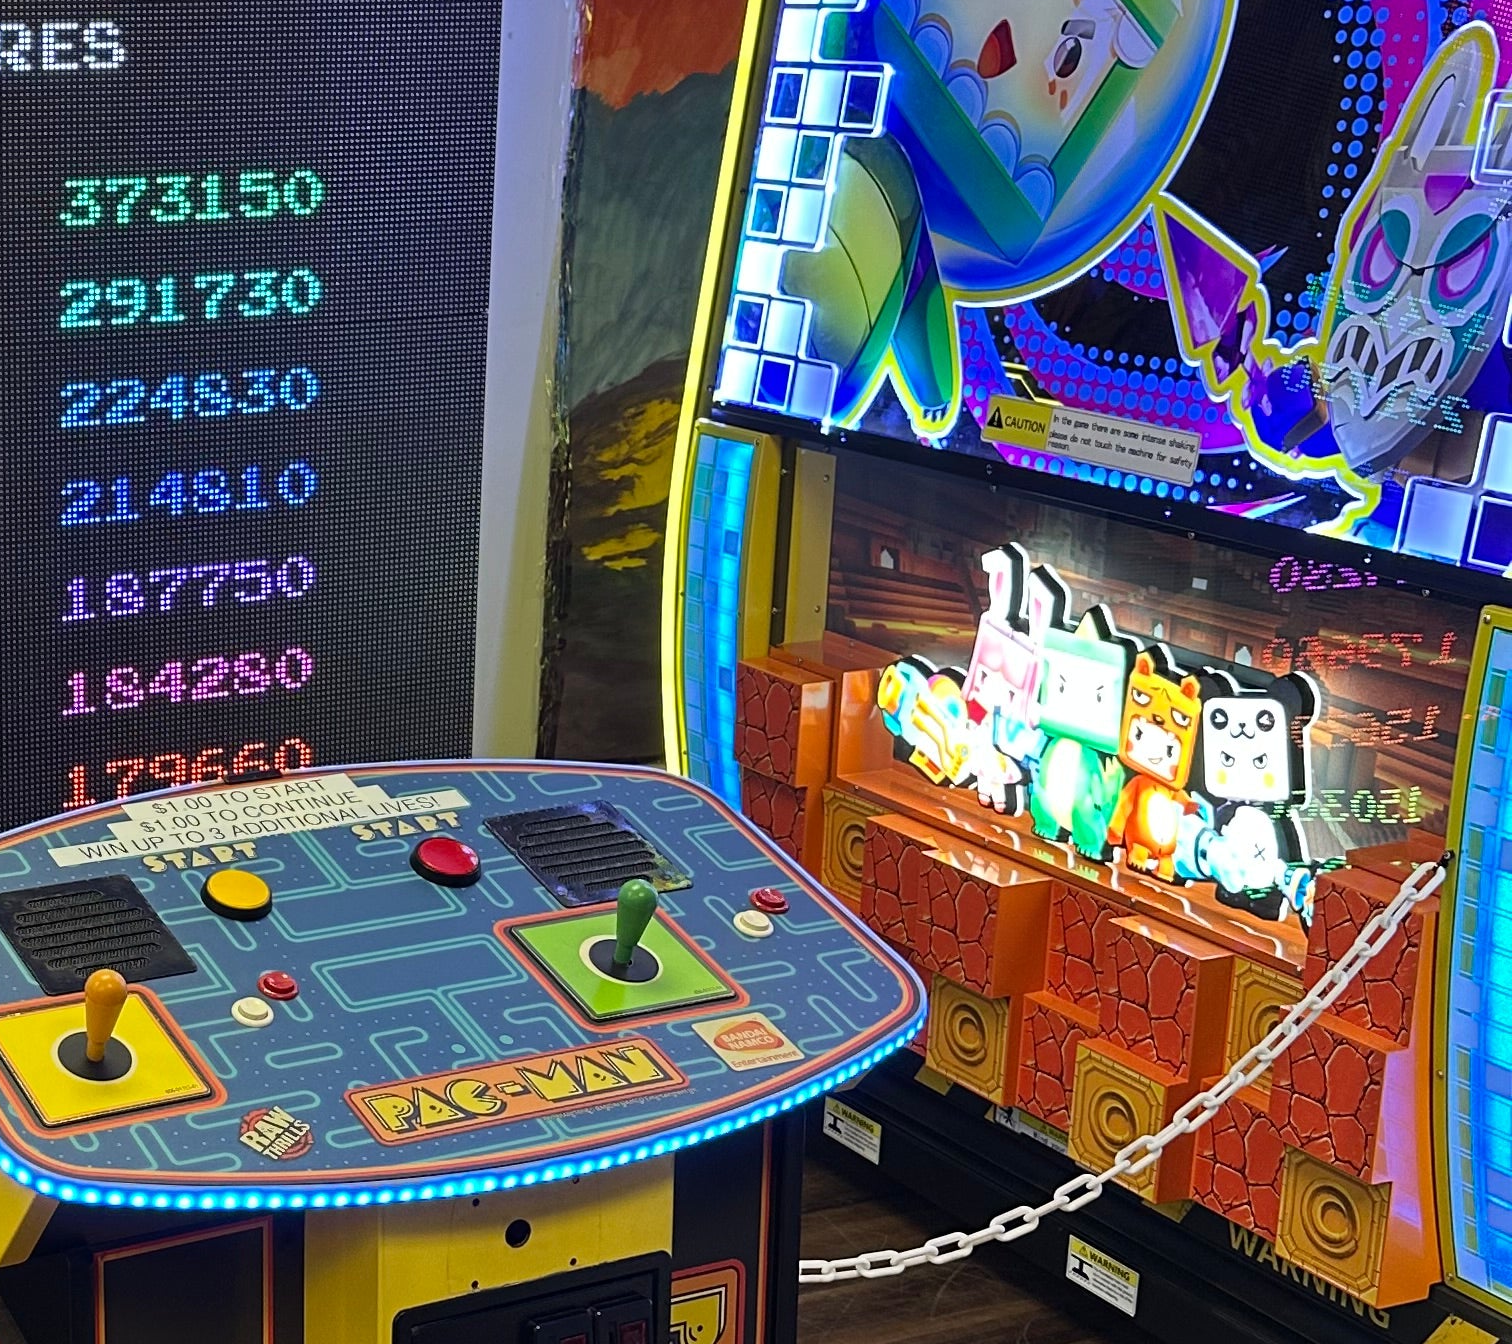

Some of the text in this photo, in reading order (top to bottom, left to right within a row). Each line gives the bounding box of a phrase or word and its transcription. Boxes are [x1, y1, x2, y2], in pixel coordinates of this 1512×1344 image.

[59, 168, 327, 227] 373150
[58, 268, 325, 330] 291730
[58, 366, 322, 429] 224830
[1004, 415, 1046, 434] CAUTION
[1080, 436, 1091, 446] not
[1094, 439, 1112, 451] touch
[1115, 442, 1126, 453] the
[1156, 450, 1167, 462] for
[58, 461, 321, 526] 214810
[59, 555, 319, 623] 187750
[61, 647, 317, 717] 184280
[62, 738, 317, 809] 179660
[139, 790, 364, 835] $1.00 TO CONTINUE
[151, 778, 330, 816] $1.00 TO START
[80, 794, 440, 861] WIN UP TO 3 ADDITIONAL LIVES!
[350, 811, 461, 843] START
[142, 841, 259, 874] START
[720, 1027, 769, 1044] BANDAI
[727, 1035, 776, 1051] NAMCO
[730, 1050, 800, 1068] Entertainment
[365, 1045, 677, 1138] PAC-MAN
[239, 1106, 296, 1153] RAW
[263, 1119, 312, 1160] THRILLS
[1089, 1251, 1130, 1281] WARNING
